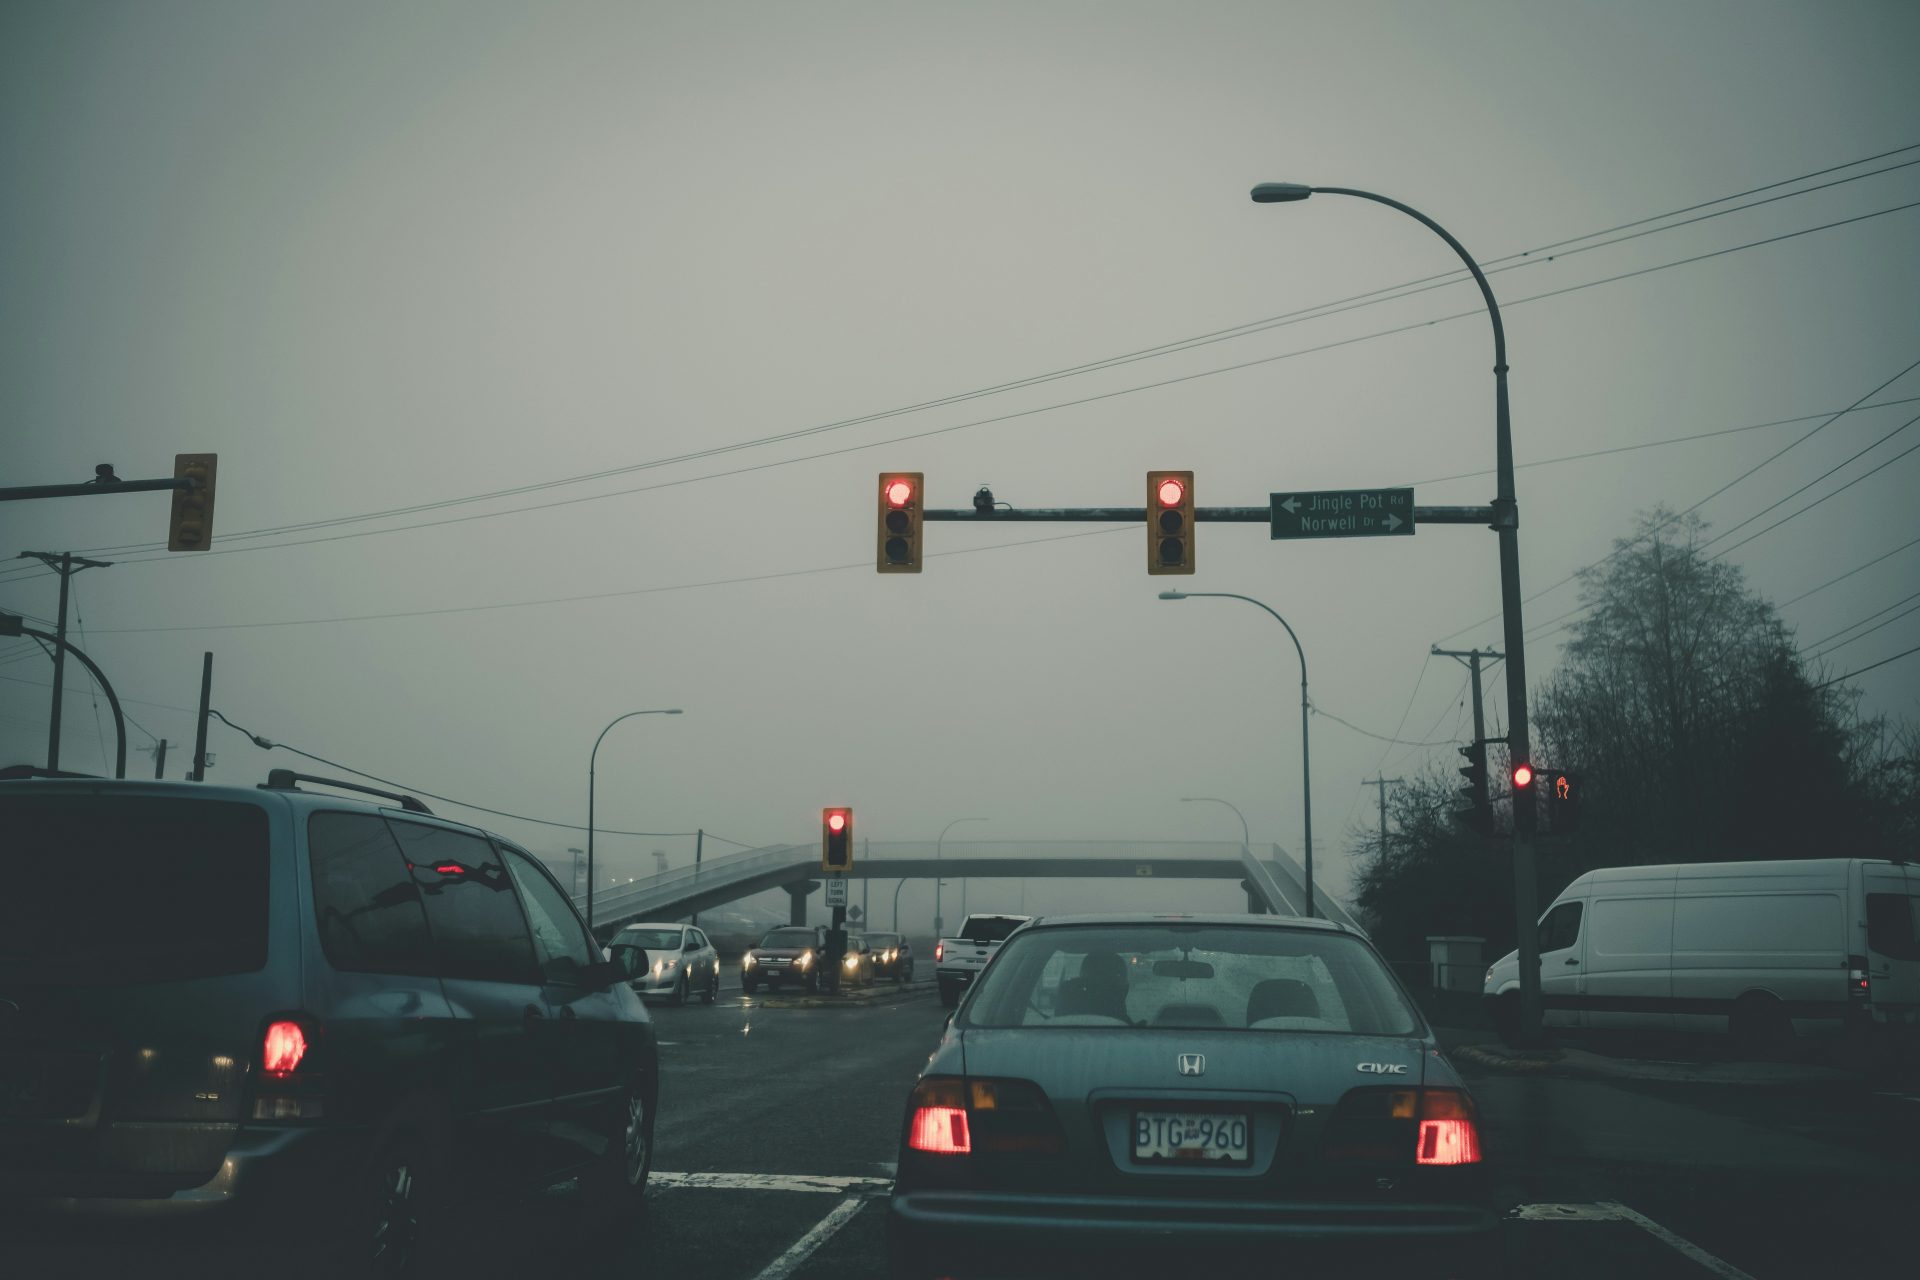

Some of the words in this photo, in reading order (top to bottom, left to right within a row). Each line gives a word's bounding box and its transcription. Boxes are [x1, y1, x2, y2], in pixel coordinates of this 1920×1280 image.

[1309, 495, 1352, 514] Jingle
[1360, 494, 1383, 509] Pot
[1390, 495, 1404, 505] Rd
[1301, 515, 1356, 531] Norwell
[1363, 517, 1375, 527] Dr
[1356, 1062, 1408, 1074] CIVIC
[1136, 1117, 1183, 1148] BTG
[1199, 1118, 1246, 1149] 960
